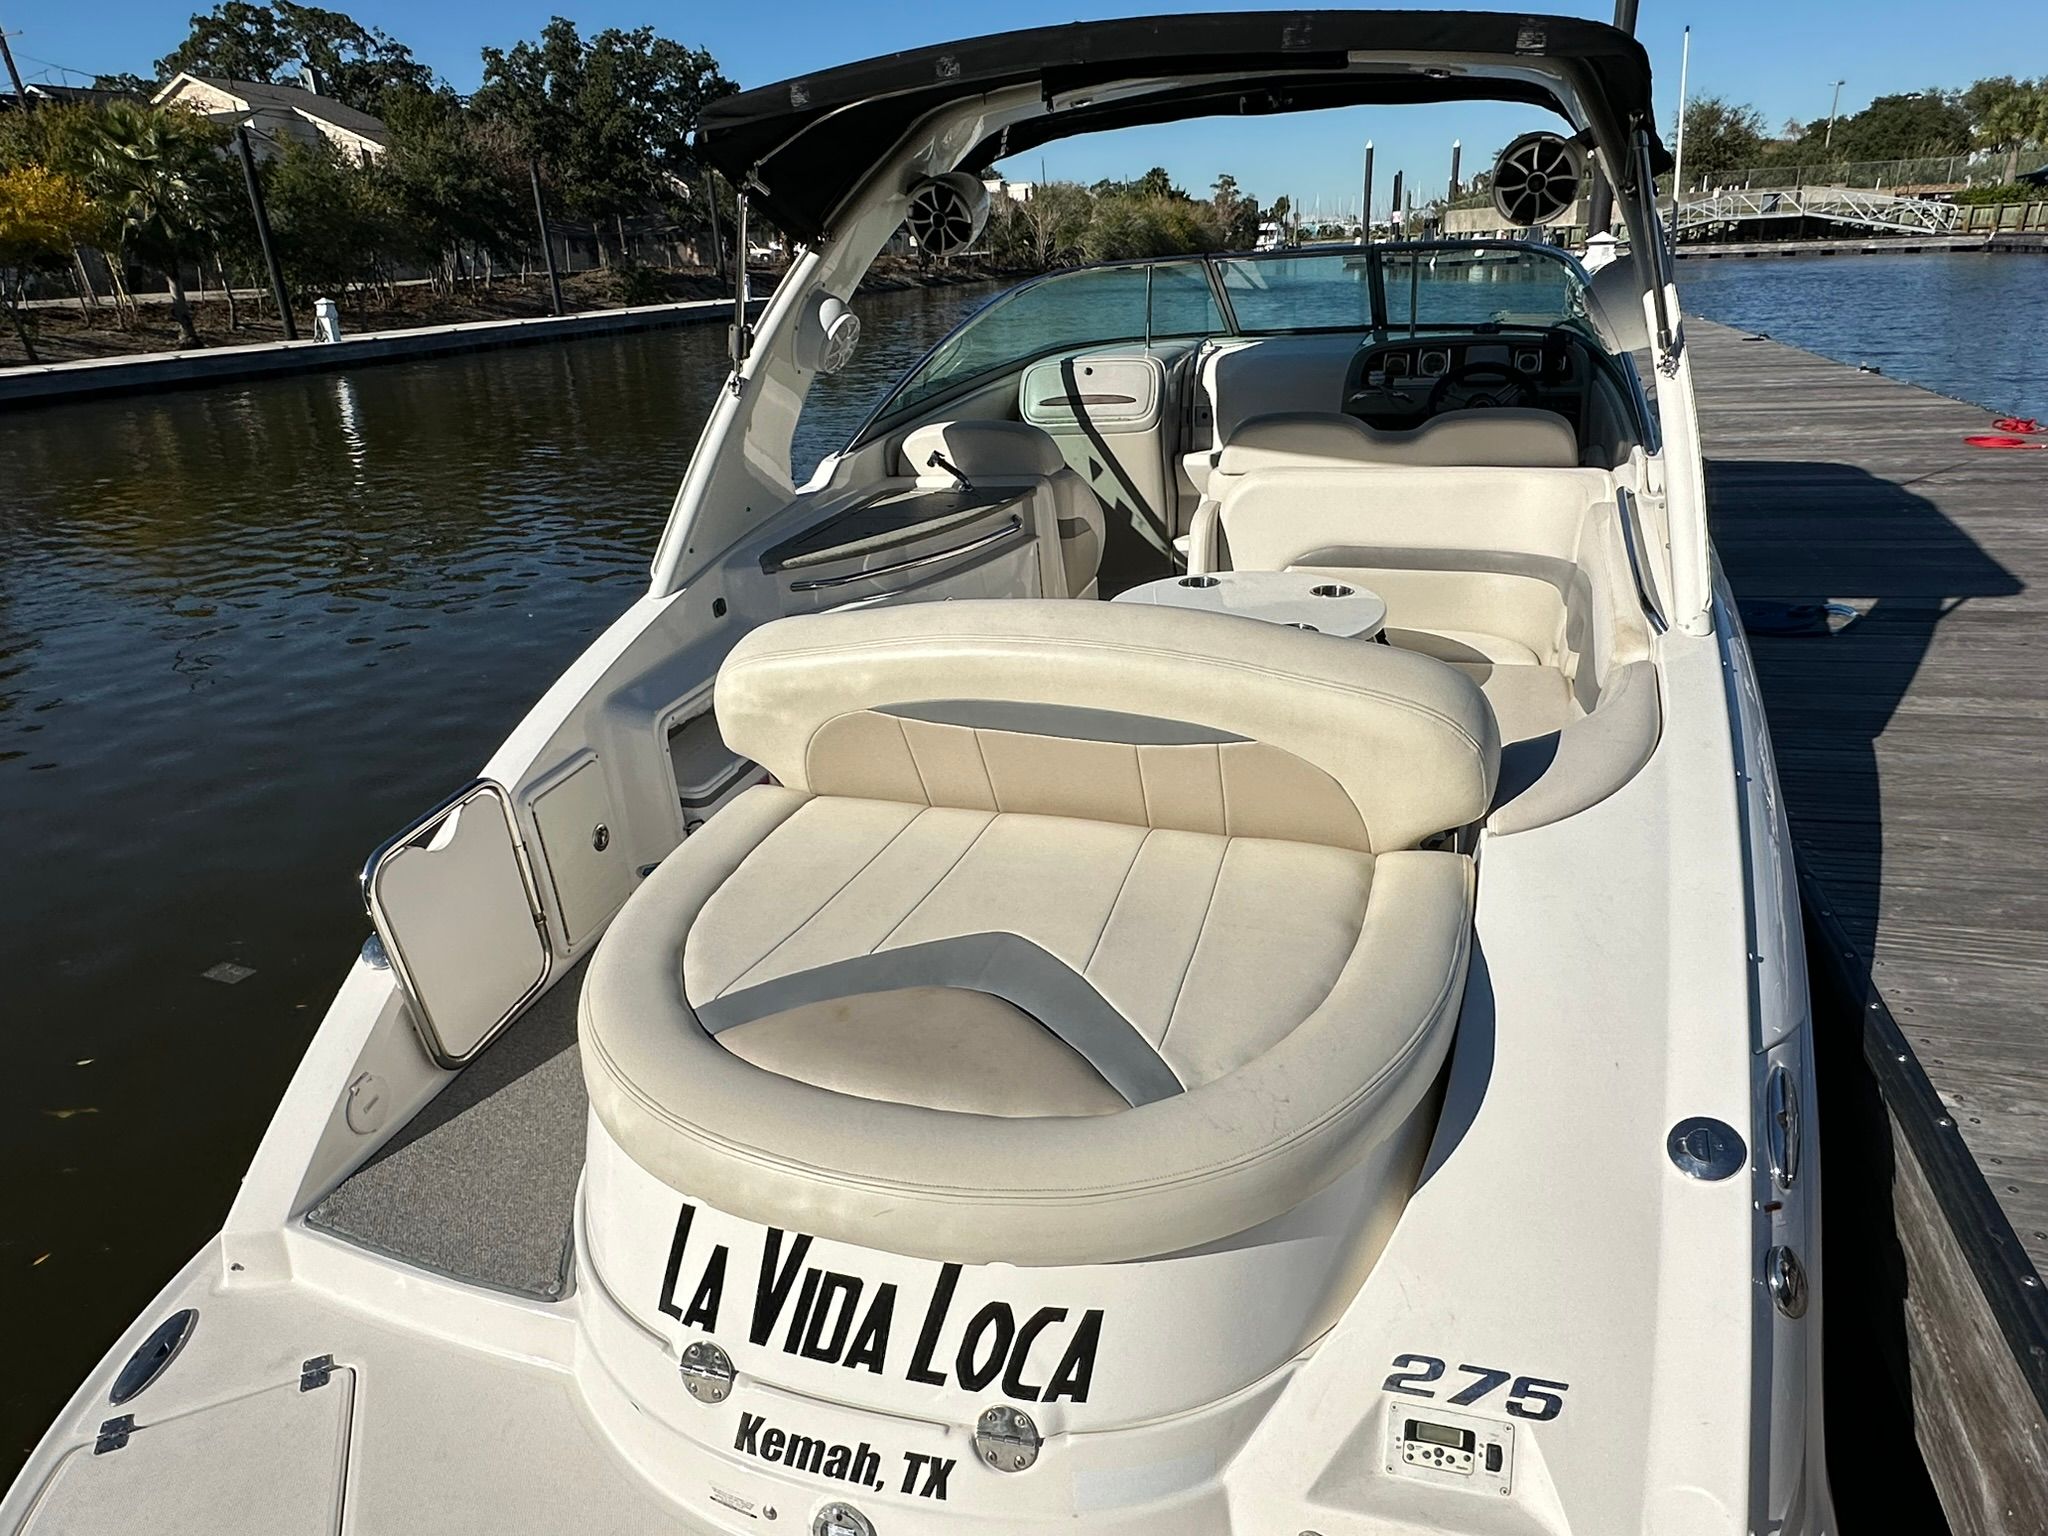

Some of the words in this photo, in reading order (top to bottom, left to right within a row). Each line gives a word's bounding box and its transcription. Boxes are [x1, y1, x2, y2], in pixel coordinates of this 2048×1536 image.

[1382, 1353, 1570, 1422] 275
[733, 1411, 886, 1493] Kemah,
[899, 1451, 957, 1501] TX
